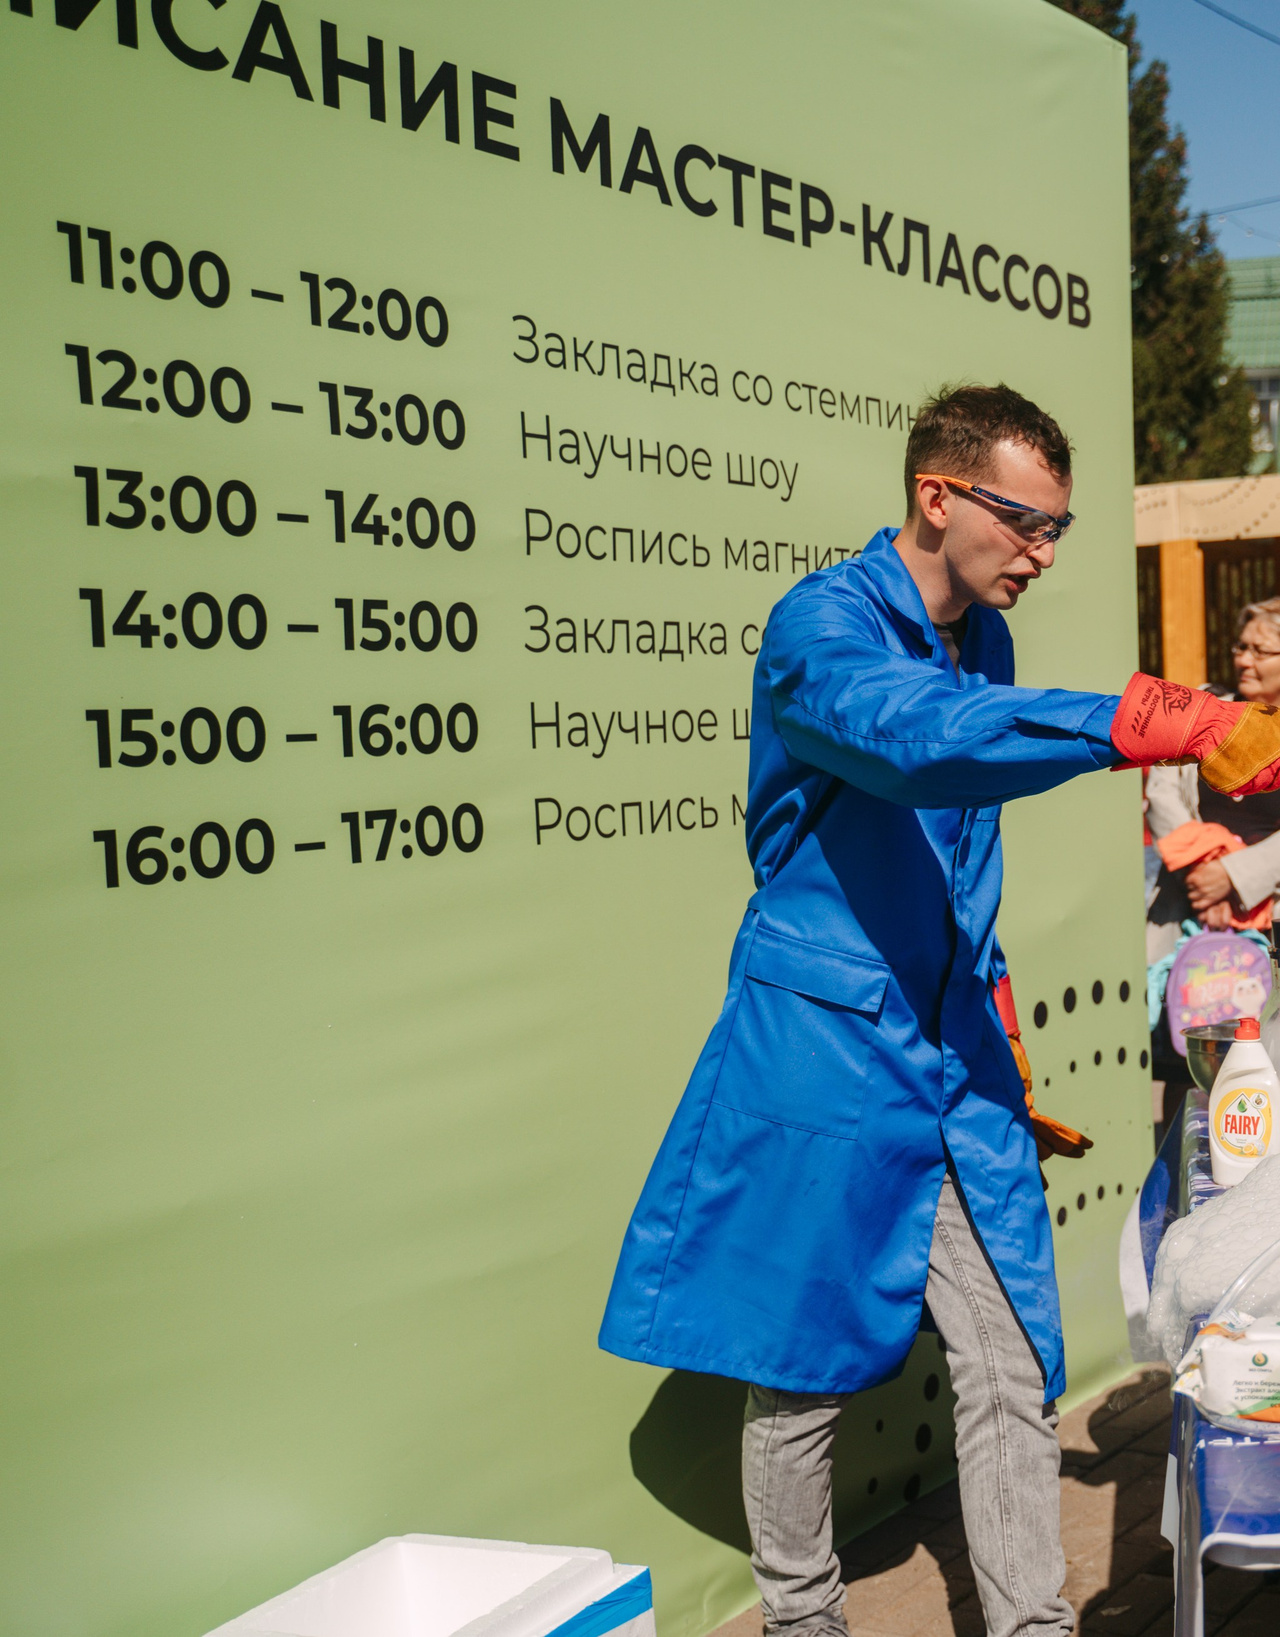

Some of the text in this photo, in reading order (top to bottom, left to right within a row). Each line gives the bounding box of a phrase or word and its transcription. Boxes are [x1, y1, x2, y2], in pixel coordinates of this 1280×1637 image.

[10, 0, 1091, 329] САНИЕ МАСТЕР-КЛАССОВ
[57, 221, 230, 308] 11:00
[300, 271, 448, 347] 12:00
[512, 315, 719, 397] Закладка
[732, 370, 773, 407] со
[65, 344, 250, 423] 12:00
[319, 382, 465, 450] 13:00
[520, 412, 799, 502] Научное шоу
[74, 466, 256, 536] 13:00
[325, 490, 475, 551] 14:00
[525, 508, 710, 567] Роспись
[79, 588, 267, 650] 14:00
[335, 598, 477, 652] 15:00
[524, 604, 727, 662] Закладка
[1138, 694, 1161, 738] ВОСТОЧНЫЕ
[1141, 686, 1155, 706] ТИГРЫ
[86, 706, 265, 768] 15:00
[333, 703, 478, 757] 16:00
[530, 701, 718, 758] Научное
[93, 819, 274, 888] 16:00
[341, 803, 483, 863] 17:00
[534, 792, 719, 846] Роспись
[1224, 1114, 1260, 1136] FAIRY
